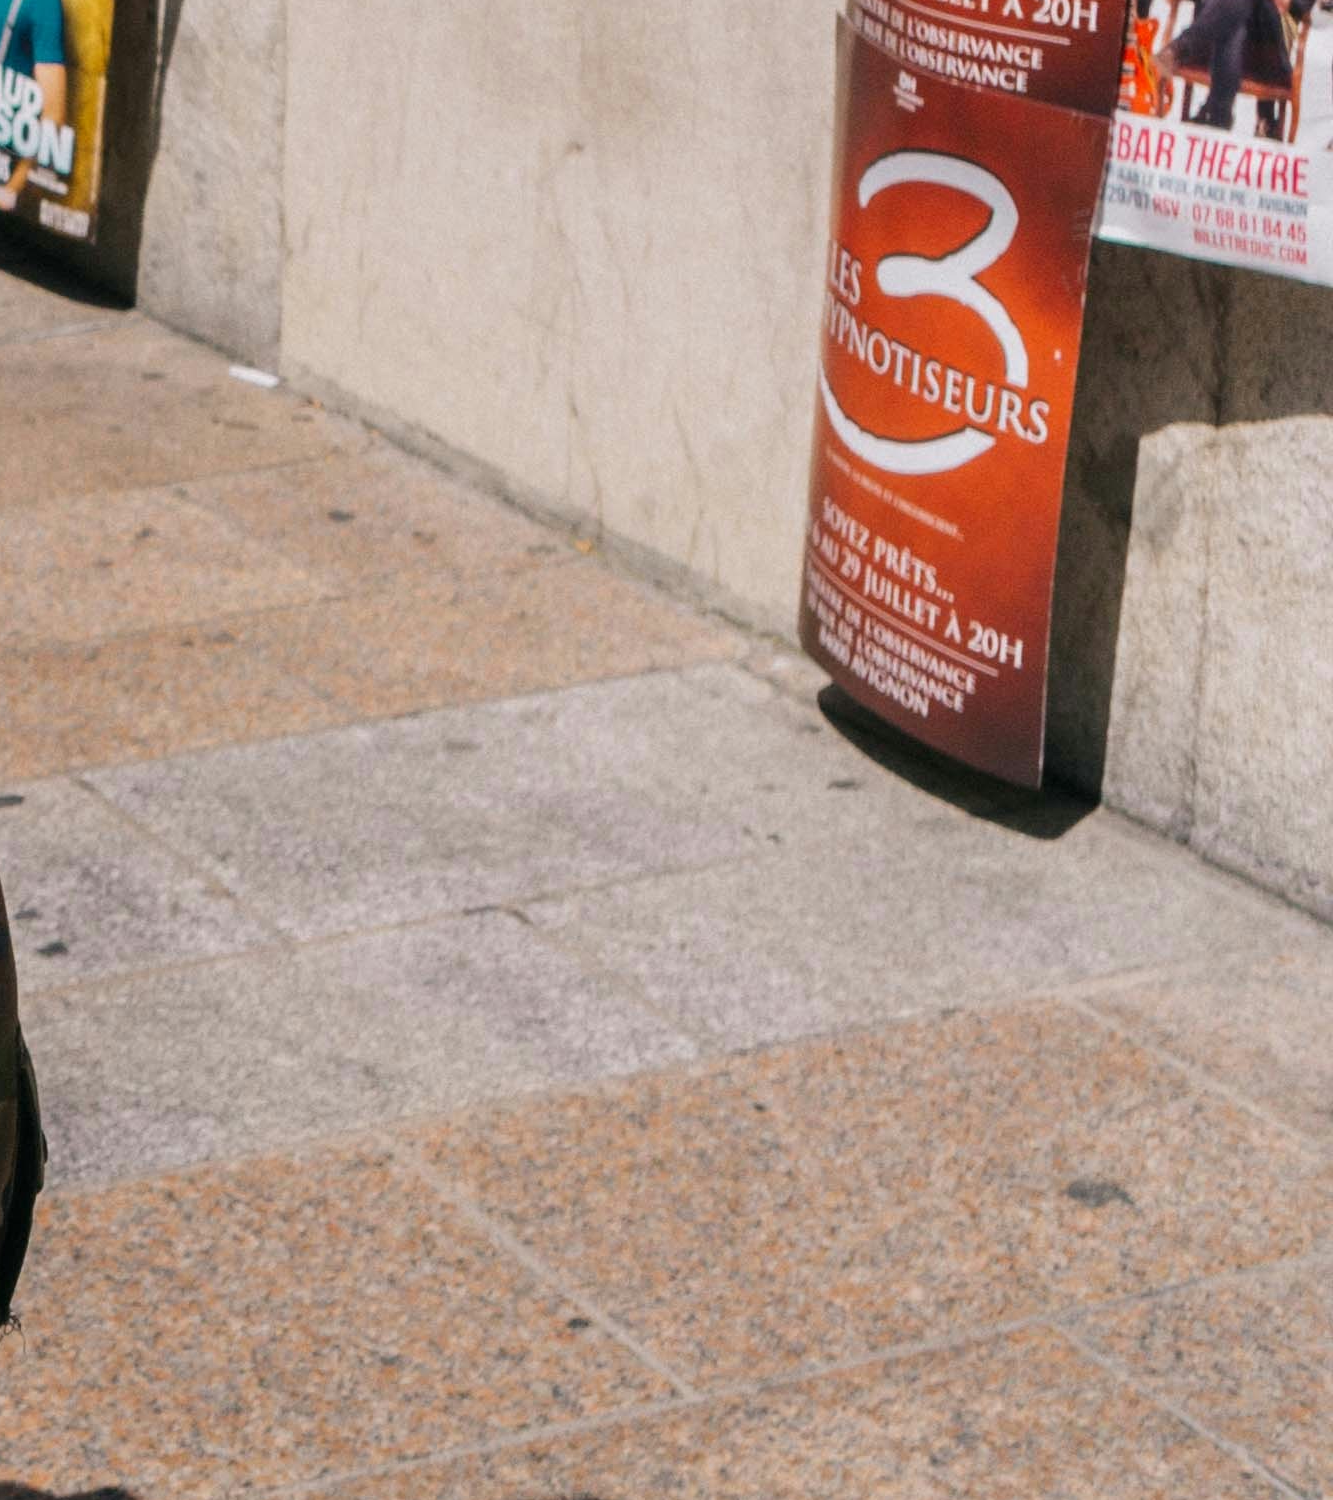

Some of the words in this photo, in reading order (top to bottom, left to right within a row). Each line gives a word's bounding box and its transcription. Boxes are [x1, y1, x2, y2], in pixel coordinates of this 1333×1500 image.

[907, 16, 1043, 70] L'OBSERVANCE
[1185, 136, 1309, 198] THEATRE
[828, 242, 863, 306] LES
[864, 564, 942, 631] JUILLET
[944, 608, 962, 644] À
[967, 620, 1025, 670] 20H
